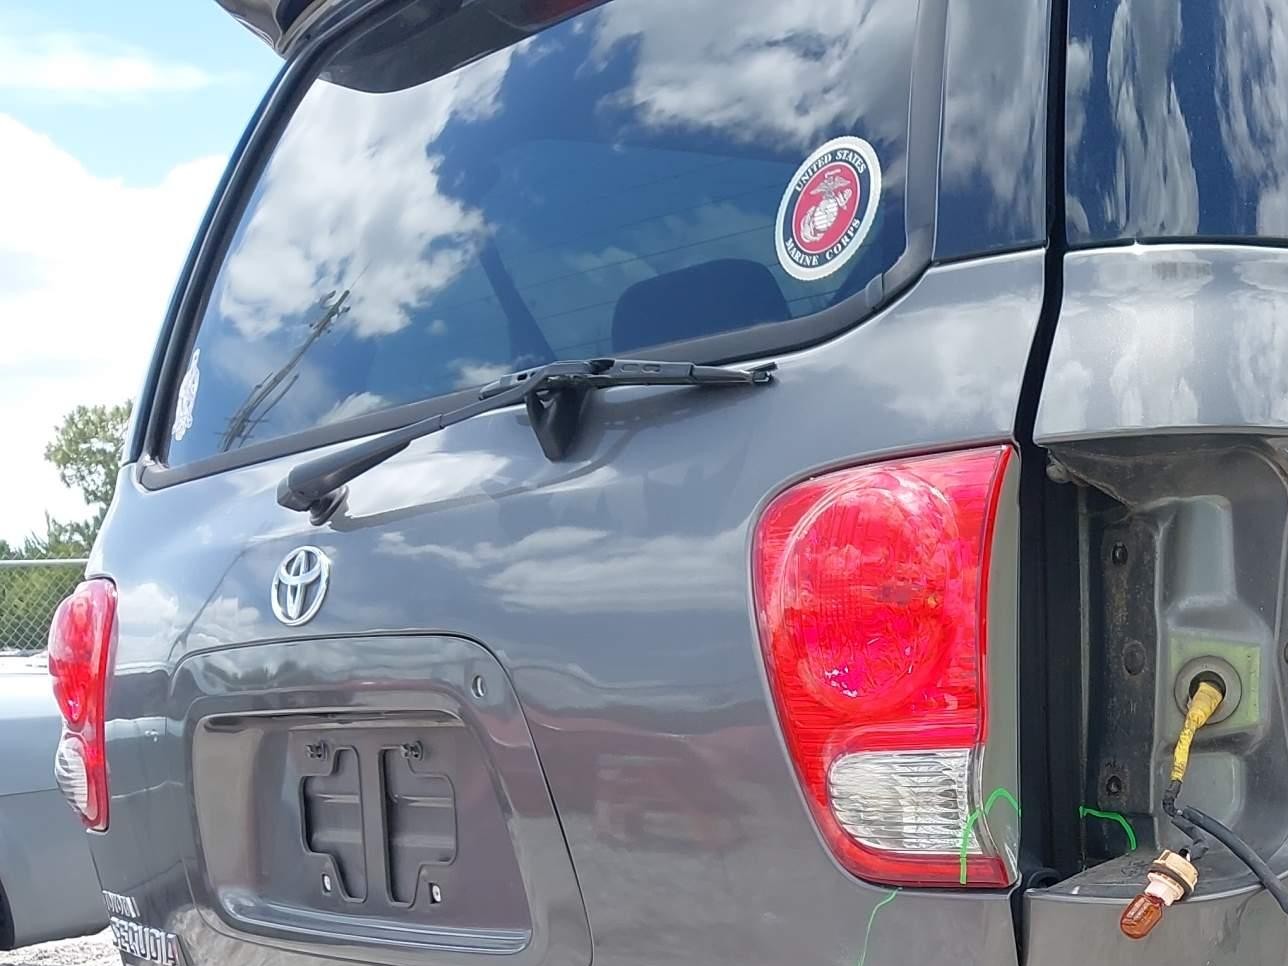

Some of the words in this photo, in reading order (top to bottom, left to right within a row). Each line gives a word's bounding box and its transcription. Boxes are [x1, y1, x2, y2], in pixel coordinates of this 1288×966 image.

[795, 152, 833, 192] UNITED
[835, 150, 867, 174] STATES
[785, 237, 820, 266] MARINE
[825, 218, 861, 260] CORPS
